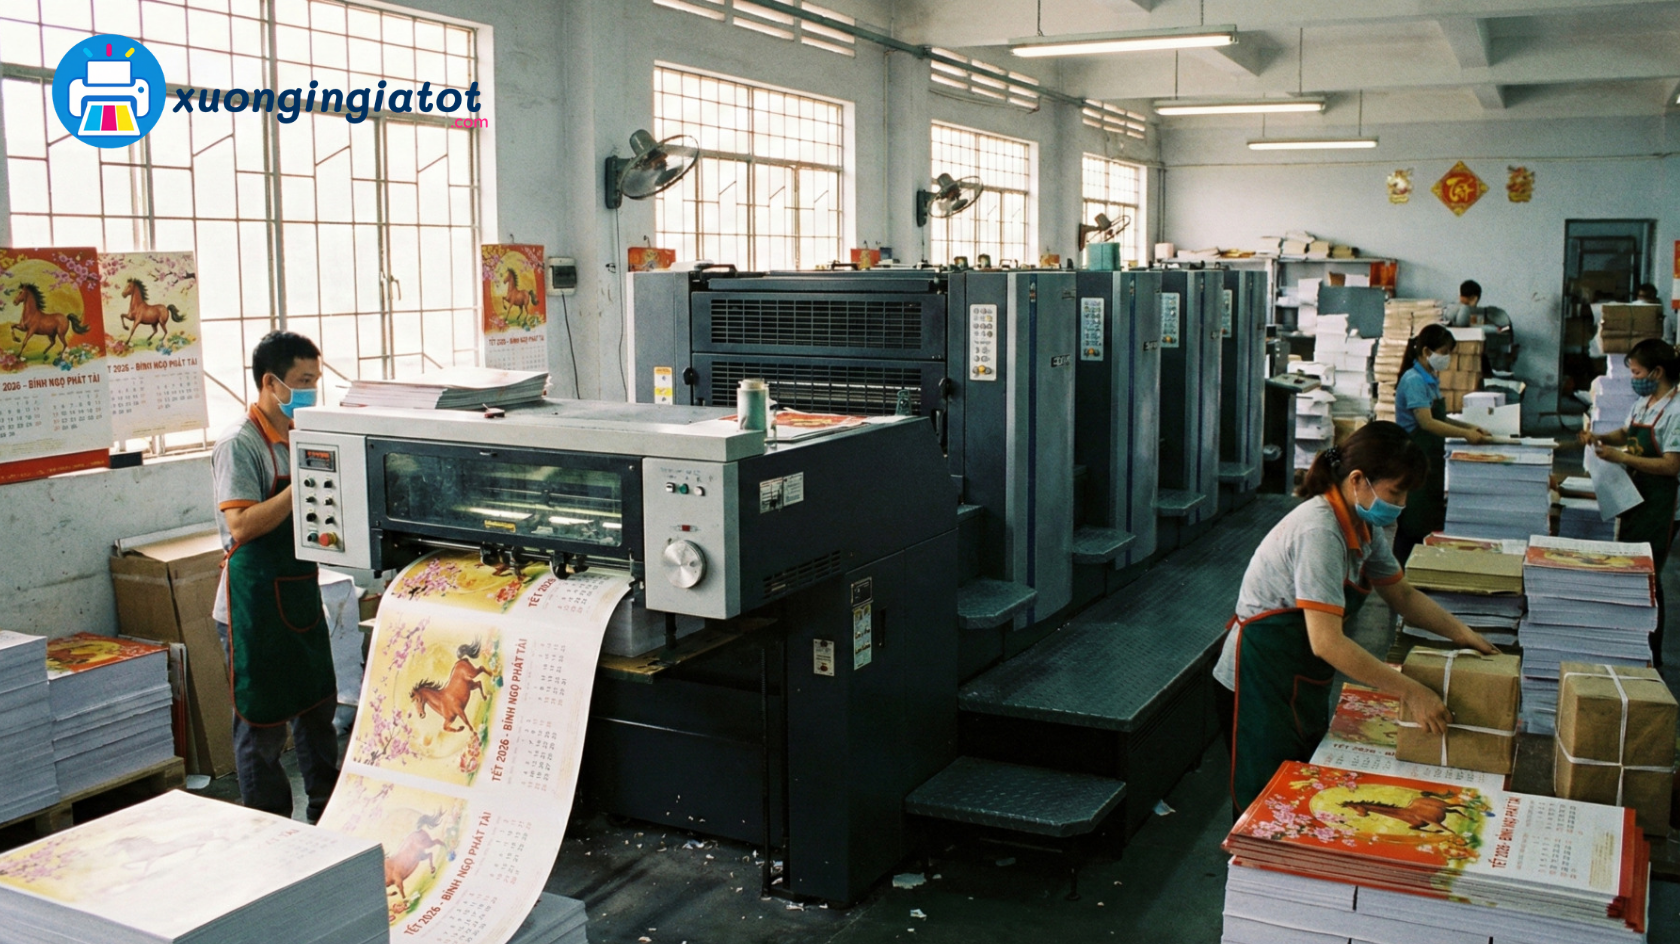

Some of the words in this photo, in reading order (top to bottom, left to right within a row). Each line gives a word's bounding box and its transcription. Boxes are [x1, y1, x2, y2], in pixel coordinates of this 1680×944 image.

[511, 655, 524, 682] PHÁT
[508, 684, 522, 705] NGỌ
[496, 739, 510, 763] 2026
[418, 906, 441, 925] 2026
[457, 857, 475, 879] NGỌ
[468, 830, 485, 856] PHÁT
